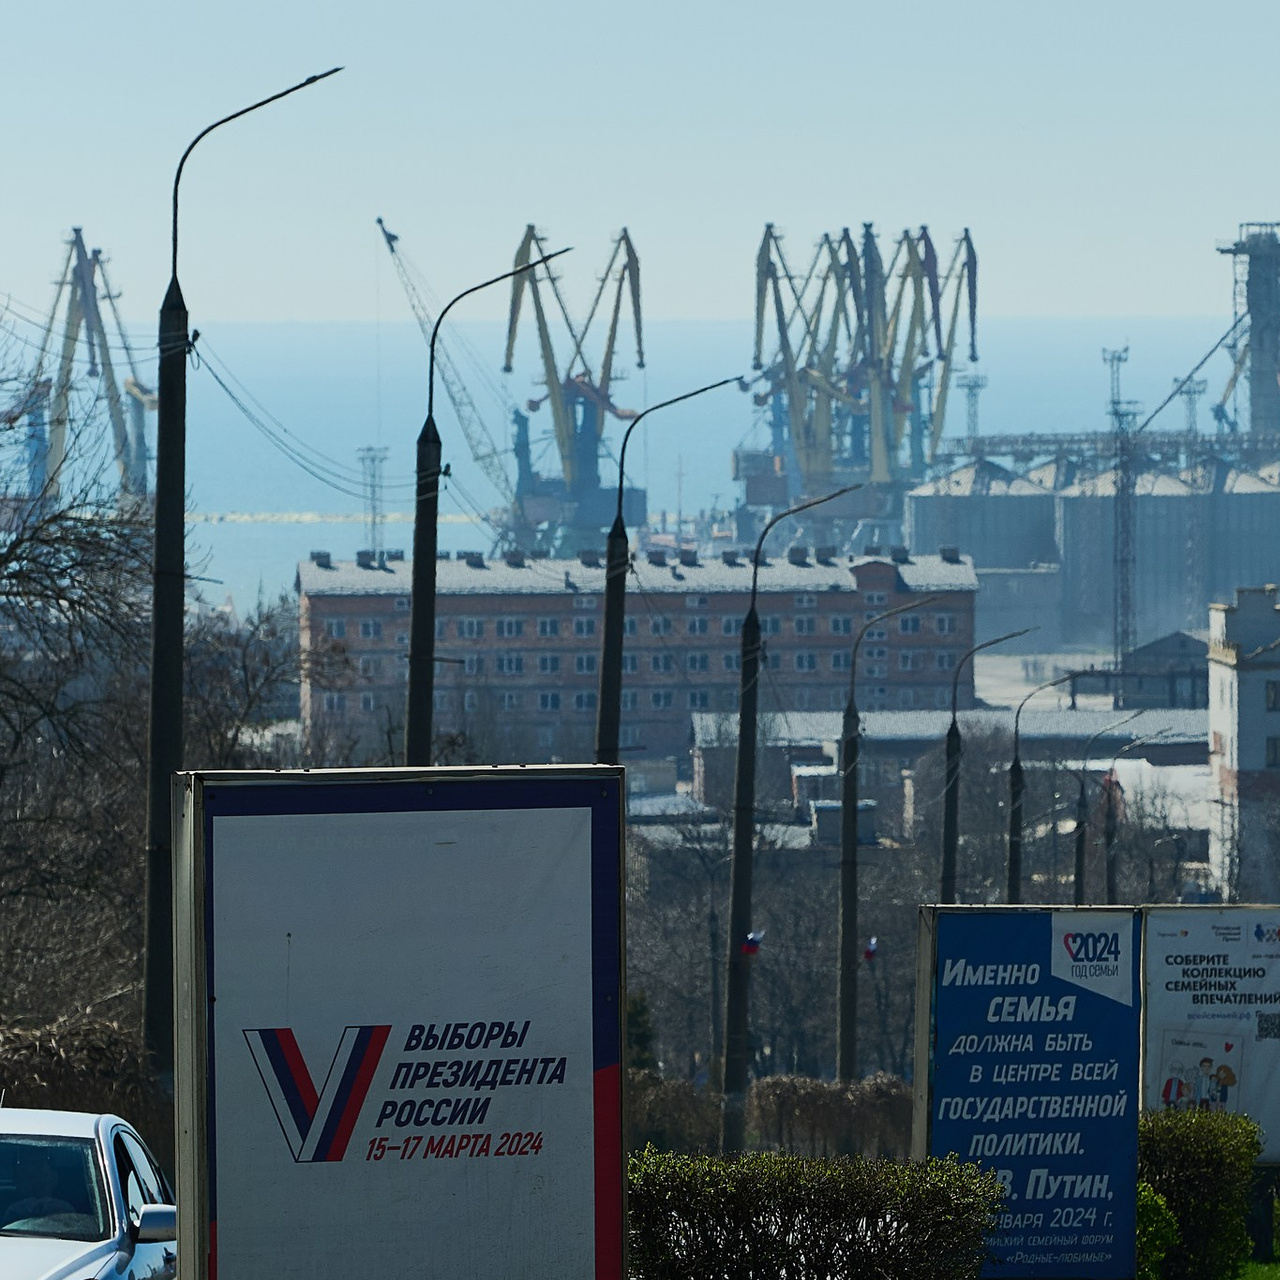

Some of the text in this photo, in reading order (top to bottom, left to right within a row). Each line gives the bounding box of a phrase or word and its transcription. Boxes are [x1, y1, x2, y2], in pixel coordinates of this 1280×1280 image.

[1072, 932, 1120, 963] 2024
[1165, 954, 1229, 966] СОБЕРИТЕ
[1165, 979, 1237, 992] СЕМЕЙНЫХ
[1182, 967, 1266, 980] КОЛЛЕКЦИЮ
[987, 995, 1076, 1023] СЕМЬЯ
[403, 1020, 530, 1053] ВЫБОРЫ
[949, 1033, 1092, 1056] ДОЛЖНА БЫТЬ
[390, 1056, 567, 1091] ПРЕЗИДЕНТА
[969, 1059, 1119, 1084] В ЦЕНТРЕ ВСЕЙ
[376, 1097, 490, 1128] РОССИИ
[938, 1089, 1127, 1122] ГОСУДАРСТВЕННОЙ
[423, 1133, 493, 1159] МАРТА
[495, 1132, 543, 1157] 2024
[968, 1132, 1085, 1157] ПОЛИТИКИ.
[997, 1169, 1018, 1200] В.
[1050, 1207, 1097, 1228] 2024
[1028, 1234, 1077, 1247] СЕМЕЙНЫЙ
[1081, 1234, 1113, 1246] ФОРУМ
